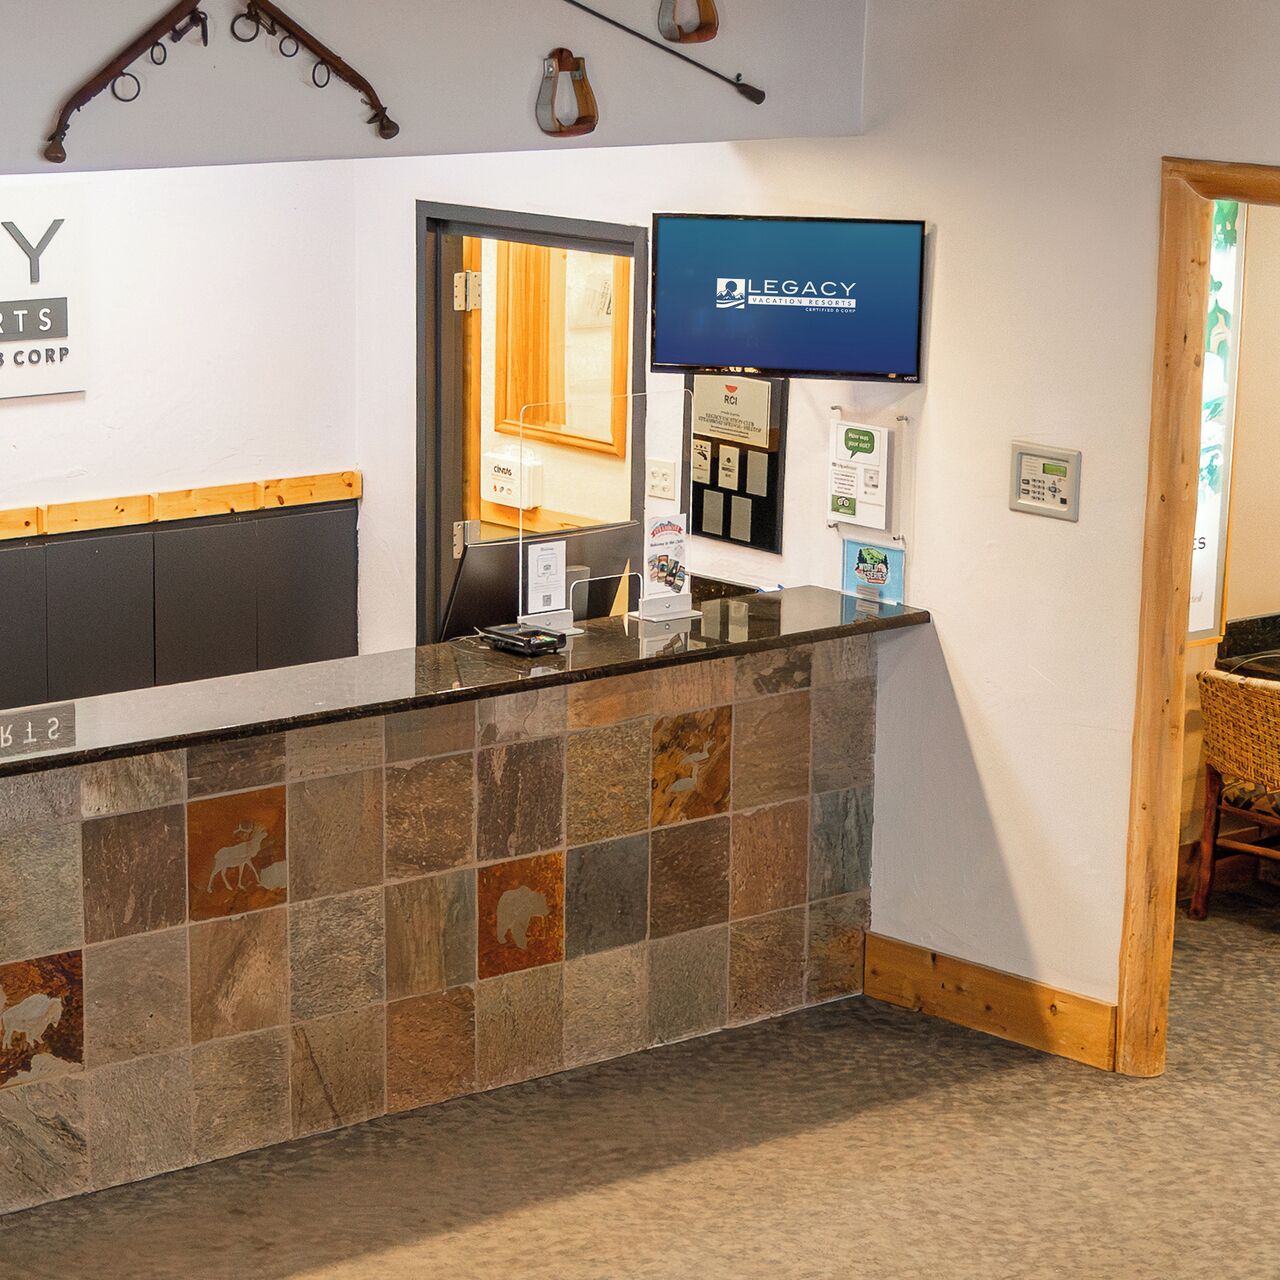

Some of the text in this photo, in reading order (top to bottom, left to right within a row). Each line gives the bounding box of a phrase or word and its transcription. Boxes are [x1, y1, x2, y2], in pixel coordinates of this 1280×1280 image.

[748, 279, 856, 297] LEGACY
[752, 297, 852, 307] VACATION RESORTS
[13, 346, 70, 367] CORP
[724, 395, 738, 405] RCI
